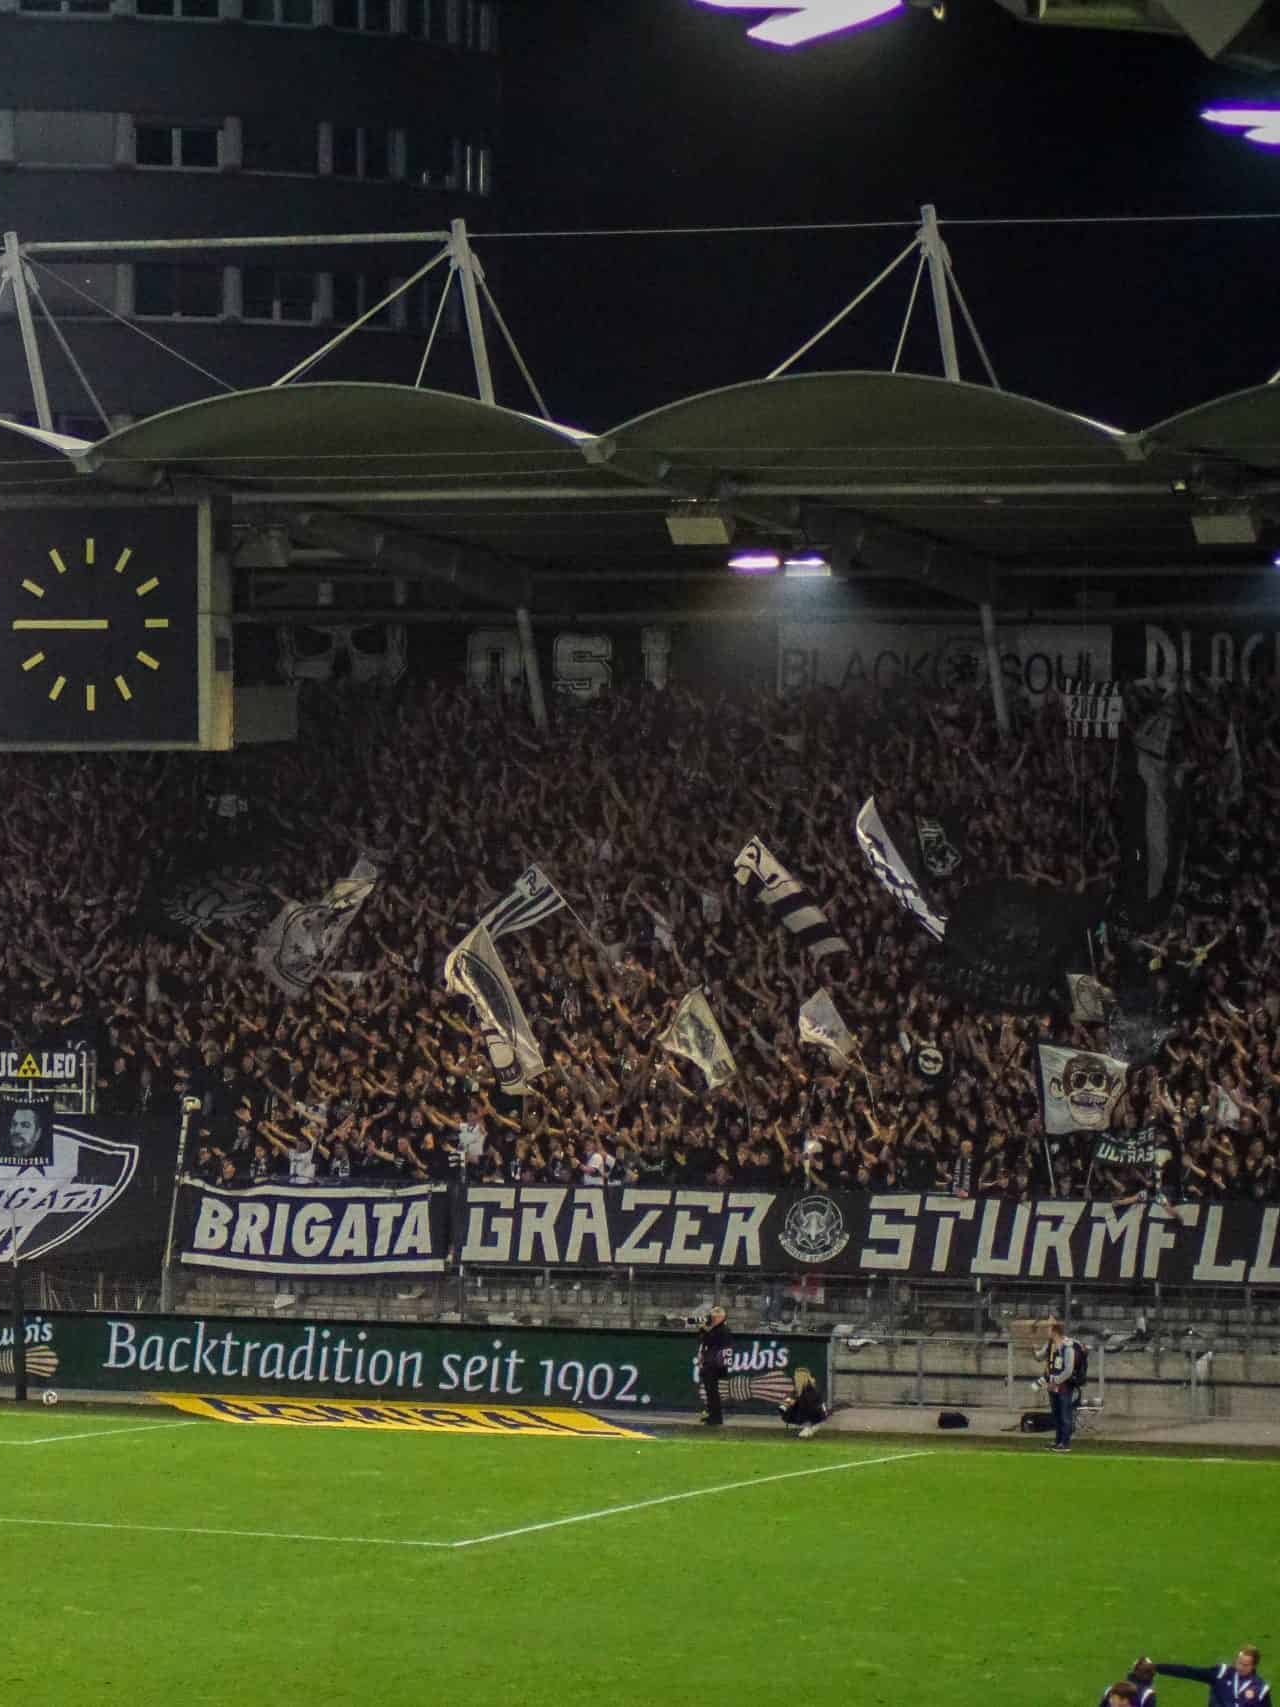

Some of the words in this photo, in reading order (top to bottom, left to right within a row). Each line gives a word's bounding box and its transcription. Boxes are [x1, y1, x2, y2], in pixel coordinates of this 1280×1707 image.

[193, 1196, 433, 1257] BRIGATA
[460, 1187, 777, 1266] GRAZER
[102, 1320, 423, 1388] Backtradition
[439, 1339, 525, 1395] seit
[539, 1359, 651, 1404] 1902.
